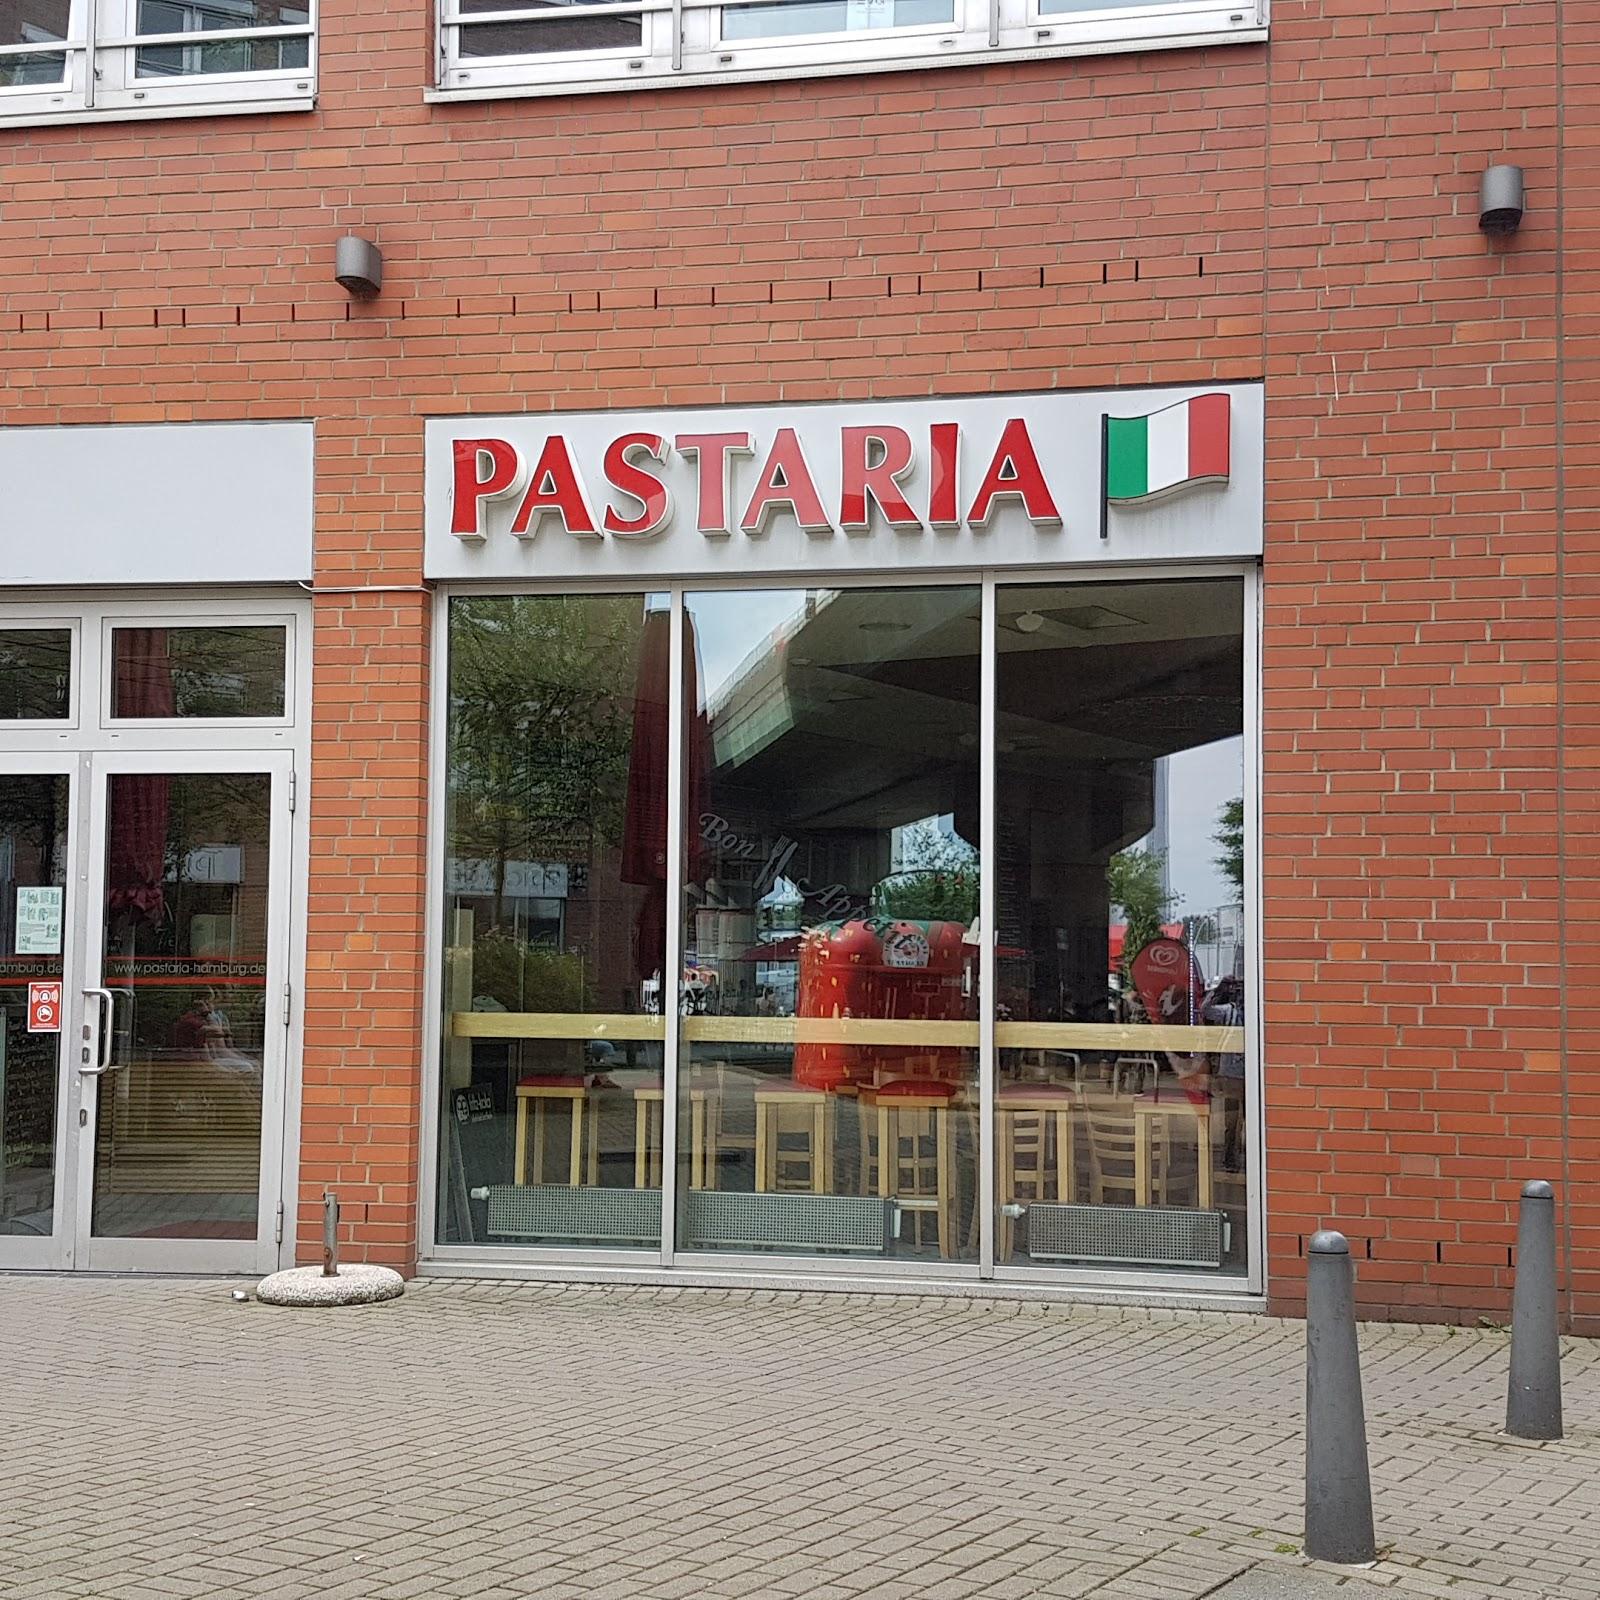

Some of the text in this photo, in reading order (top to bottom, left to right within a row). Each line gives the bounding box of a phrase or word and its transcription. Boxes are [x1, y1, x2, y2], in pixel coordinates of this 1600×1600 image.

[449, 416, 1064, 541] PASTARIA
[698, 812, 757, 859] Bon
[114, 961, 266, 977] www.pastaria-hamburg.de
